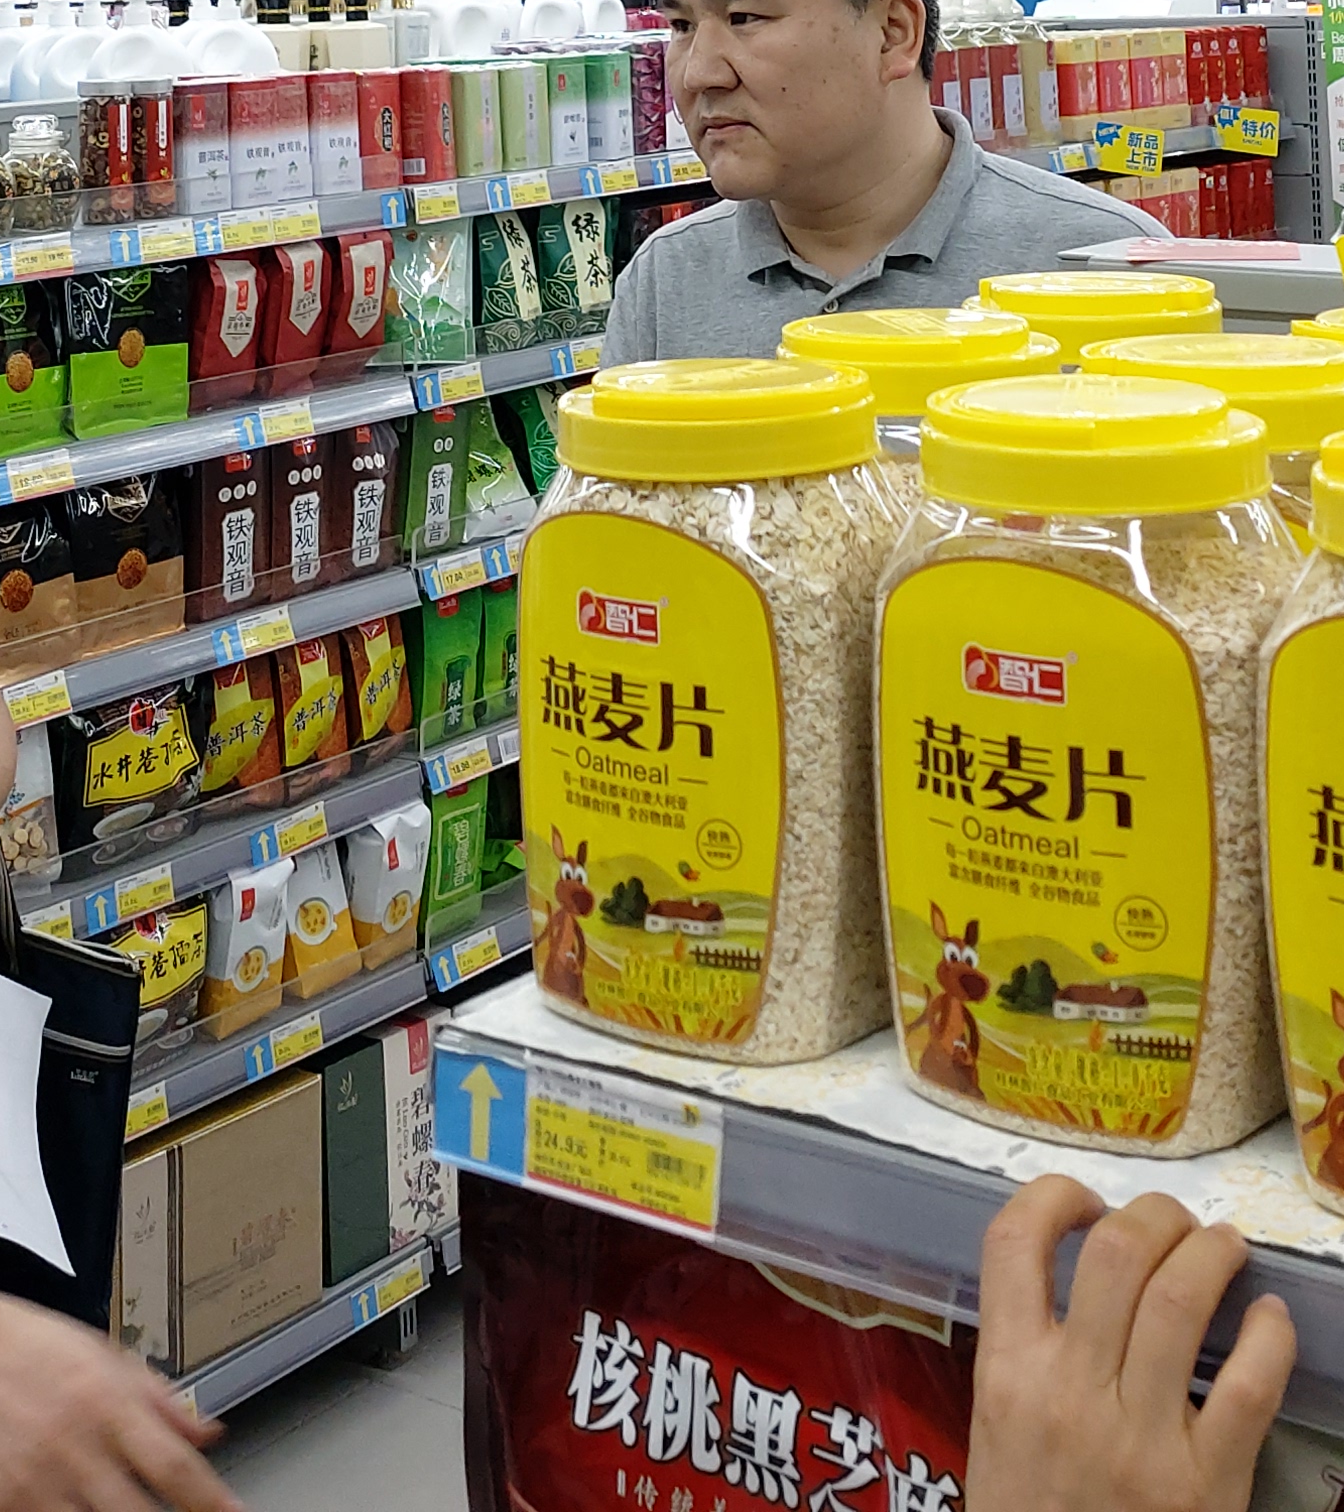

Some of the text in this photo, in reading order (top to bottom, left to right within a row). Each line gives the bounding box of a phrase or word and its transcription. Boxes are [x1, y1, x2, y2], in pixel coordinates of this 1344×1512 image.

[1126, 132, 1160, 151] 新品
[1242, 118, 1277, 141] 特价
[1126, 149, 1158, 168] 上市
[570, 210, 609, 288] 绿茶
[356, 484, 381, 561] 铁观音
[427, 469, 449, 544] 铁观音
[225, 513, 254, 595] 铁观音
[293, 499, 318, 578] 铁观音
[365, 656, 401, 705] 普洱茶
[292, 685, 337, 732] 普洱茶
[540, 654, 725, 759] 燕麦片
[206, 710, 266, 757] 普洱茶
[575, 745, 671, 788] Oatmeal
[913, 715, 1147, 831] 燕麦片
[961, 813, 1081, 862] Oatmeal
